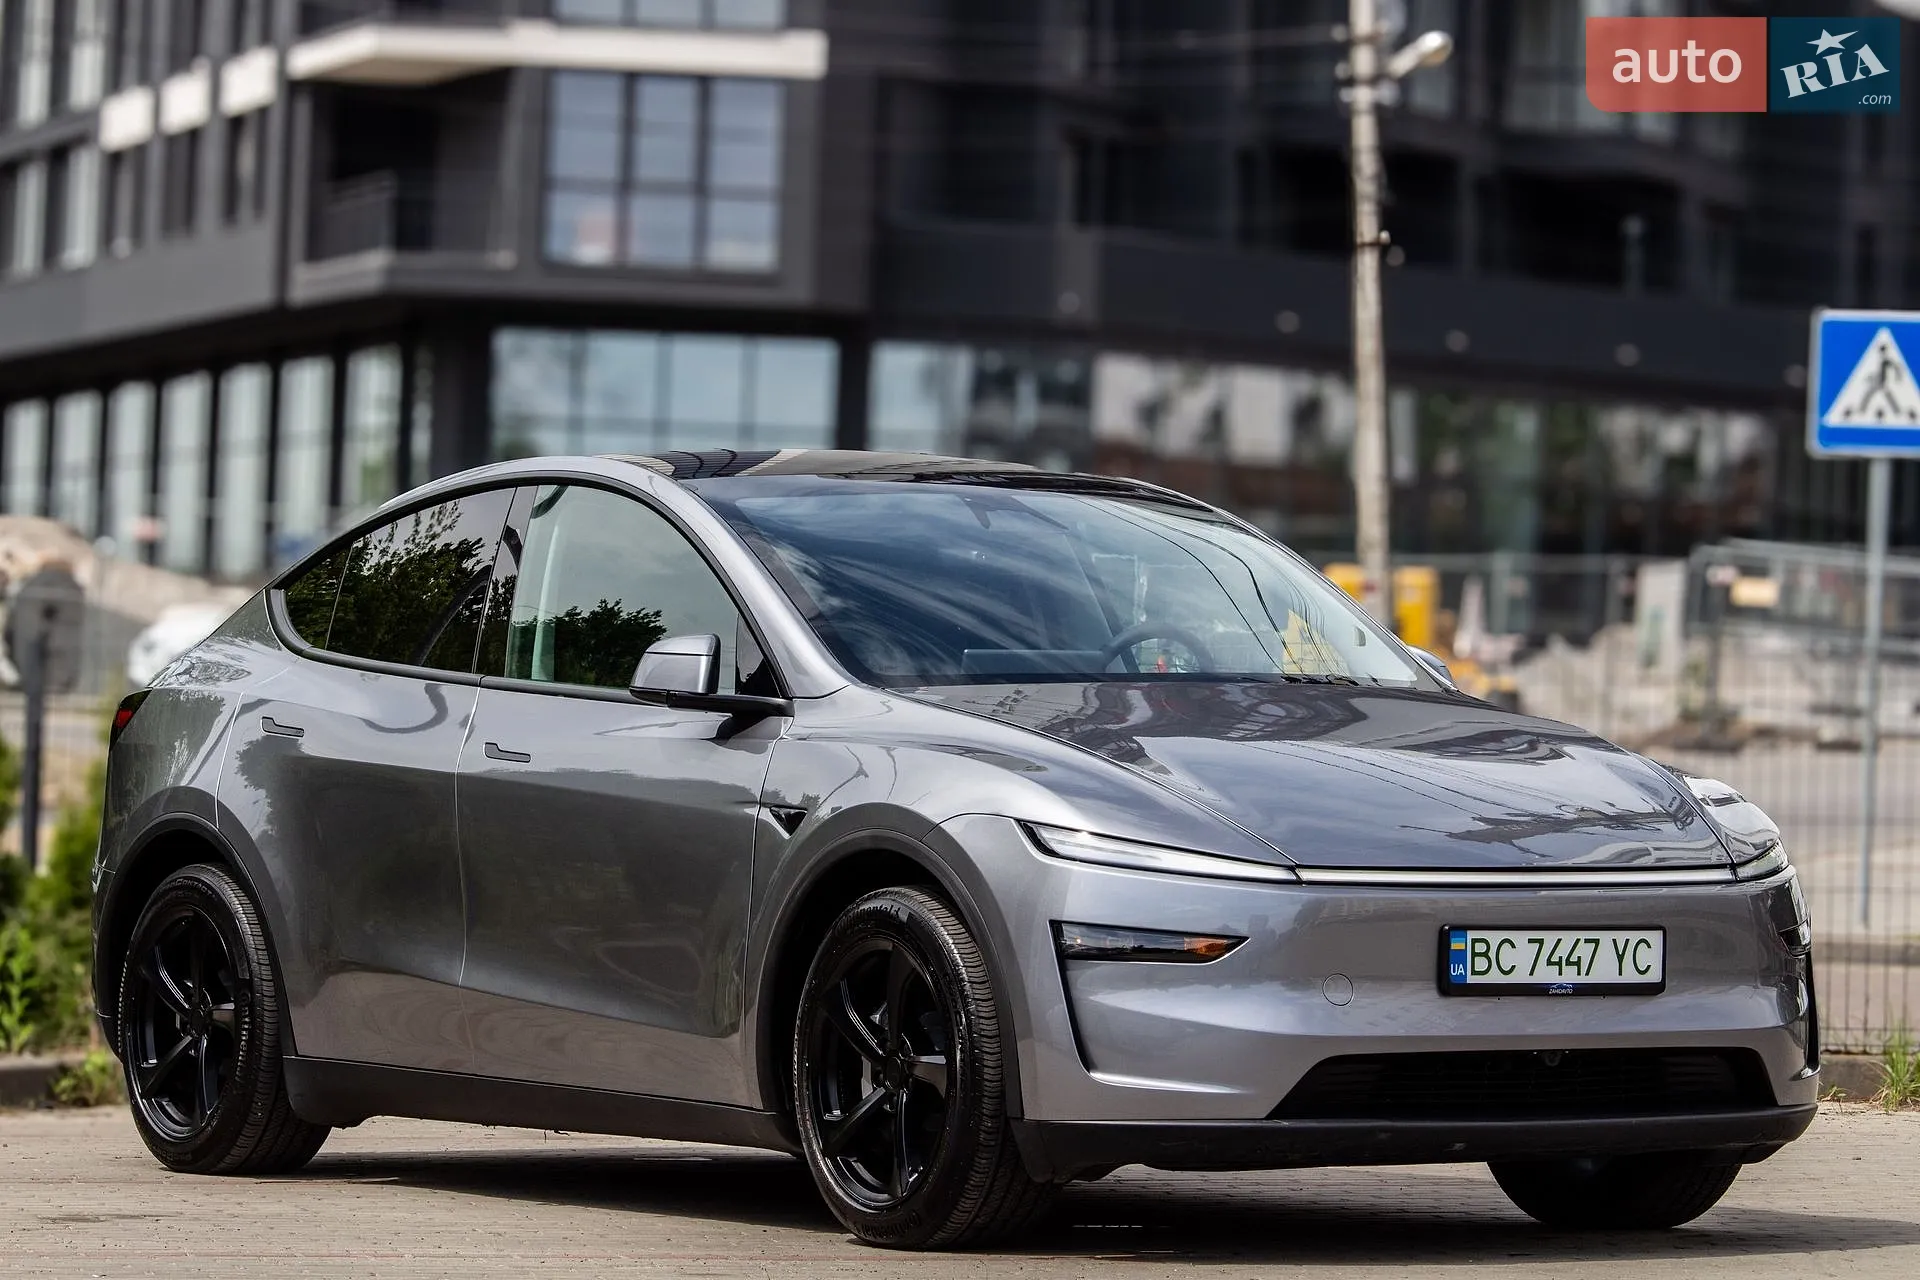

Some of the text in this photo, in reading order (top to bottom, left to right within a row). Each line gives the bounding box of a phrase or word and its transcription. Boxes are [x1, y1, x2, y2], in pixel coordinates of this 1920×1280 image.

[1450, 963, 1465, 975] UA
[1470, 938, 1652, 976] BC 7447 YC
